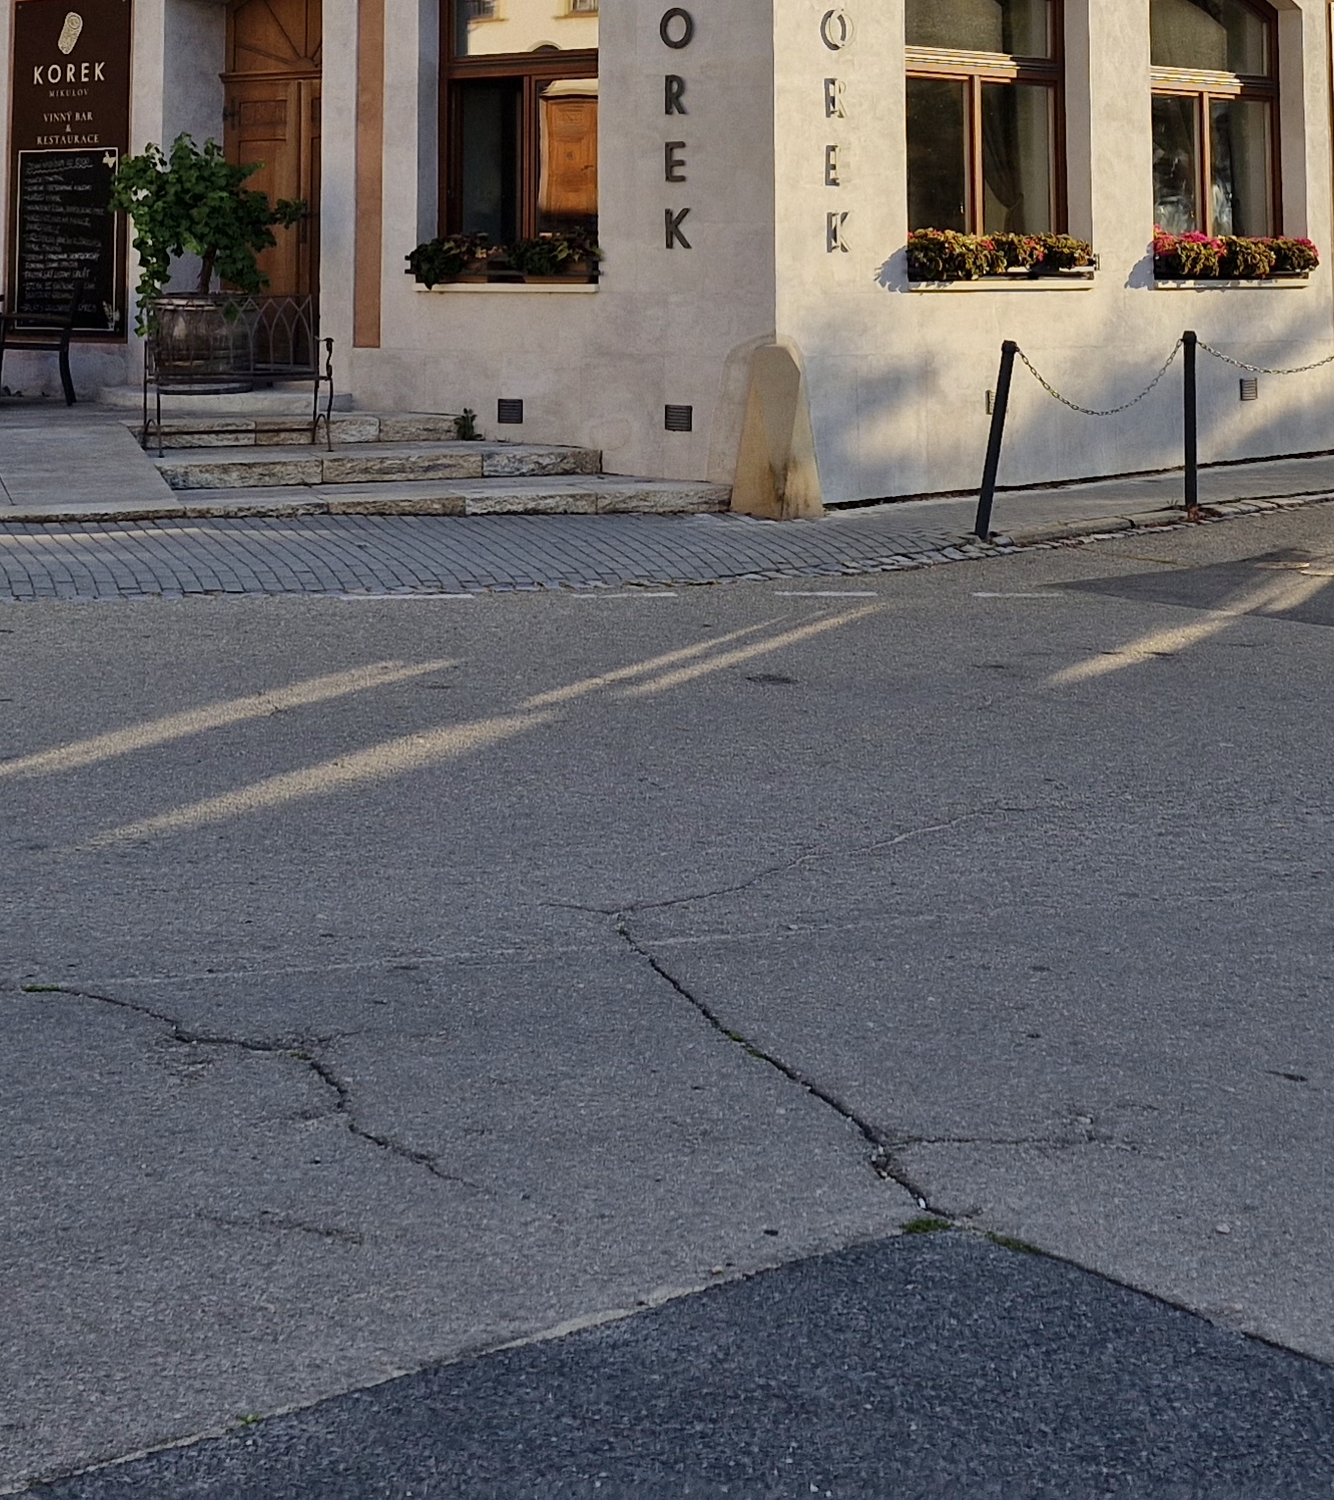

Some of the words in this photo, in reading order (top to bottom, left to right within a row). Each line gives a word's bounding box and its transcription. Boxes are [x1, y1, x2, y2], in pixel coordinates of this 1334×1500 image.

[33, 62, 105, 85] KOREK
[49, 88, 89, 97] MIKULOV
[43, 111, 72, 122] VINNÝ
[75, 112, 93, 121] BAR
[65, 124, 72, 132] &
[37, 134, 99, 145] RESTAURACE
